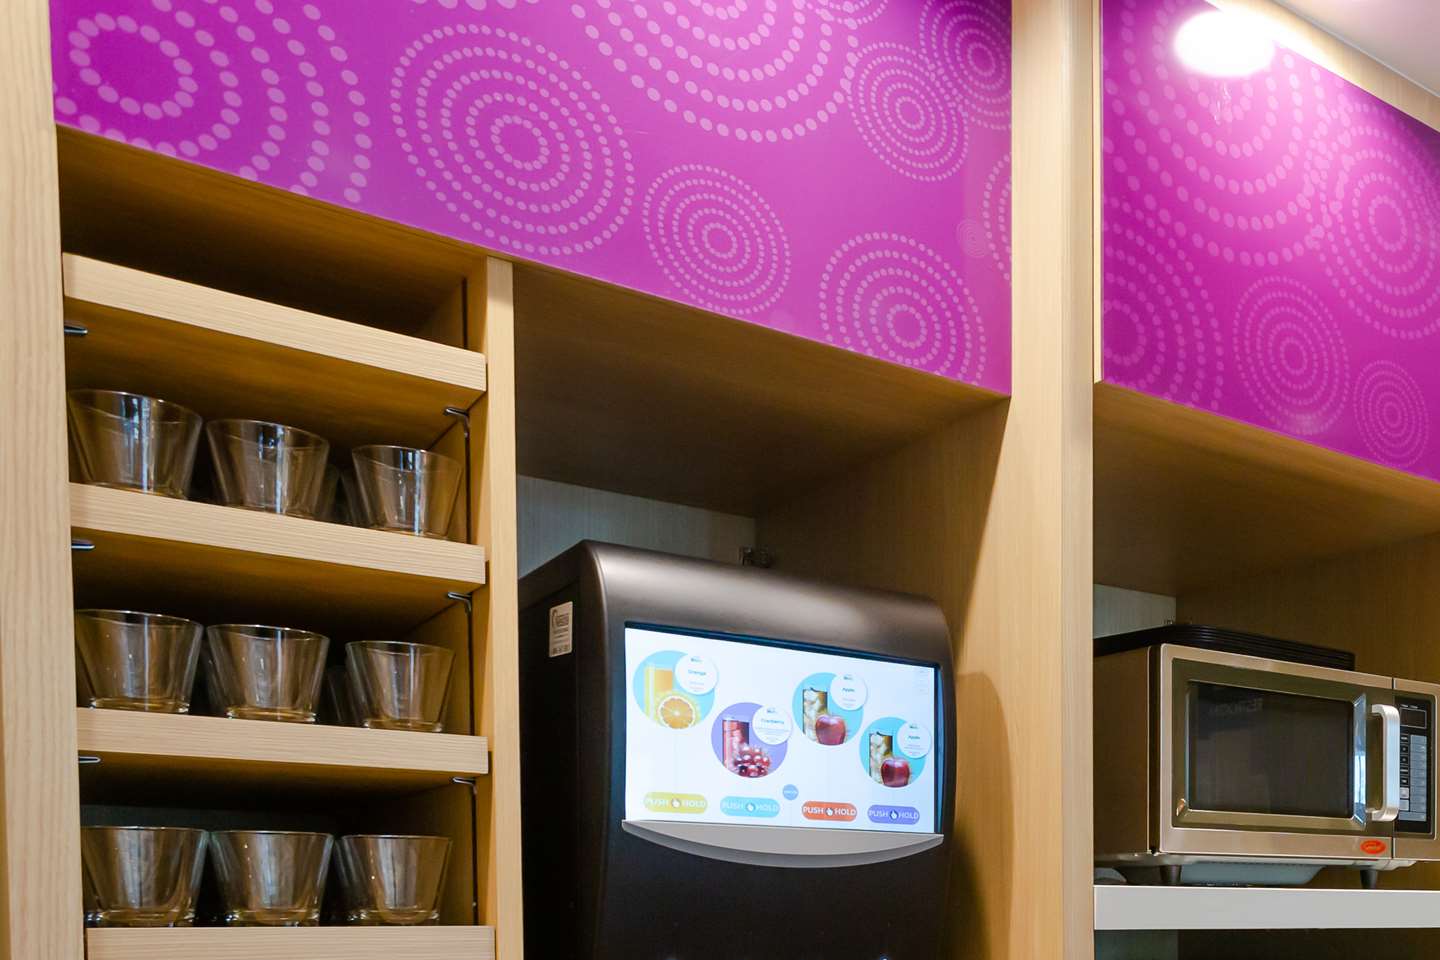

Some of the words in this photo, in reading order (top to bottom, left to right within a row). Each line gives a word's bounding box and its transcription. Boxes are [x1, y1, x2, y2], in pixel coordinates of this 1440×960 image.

[682, 799, 706, 808] HOLD
[722, 800, 744, 810] PUSH
[803, 806, 824, 814] PUSH
[835, 807, 857, 816] HOLD
[868, 810, 889, 818] PUSH
[898, 811, 919, 820] HOLD
